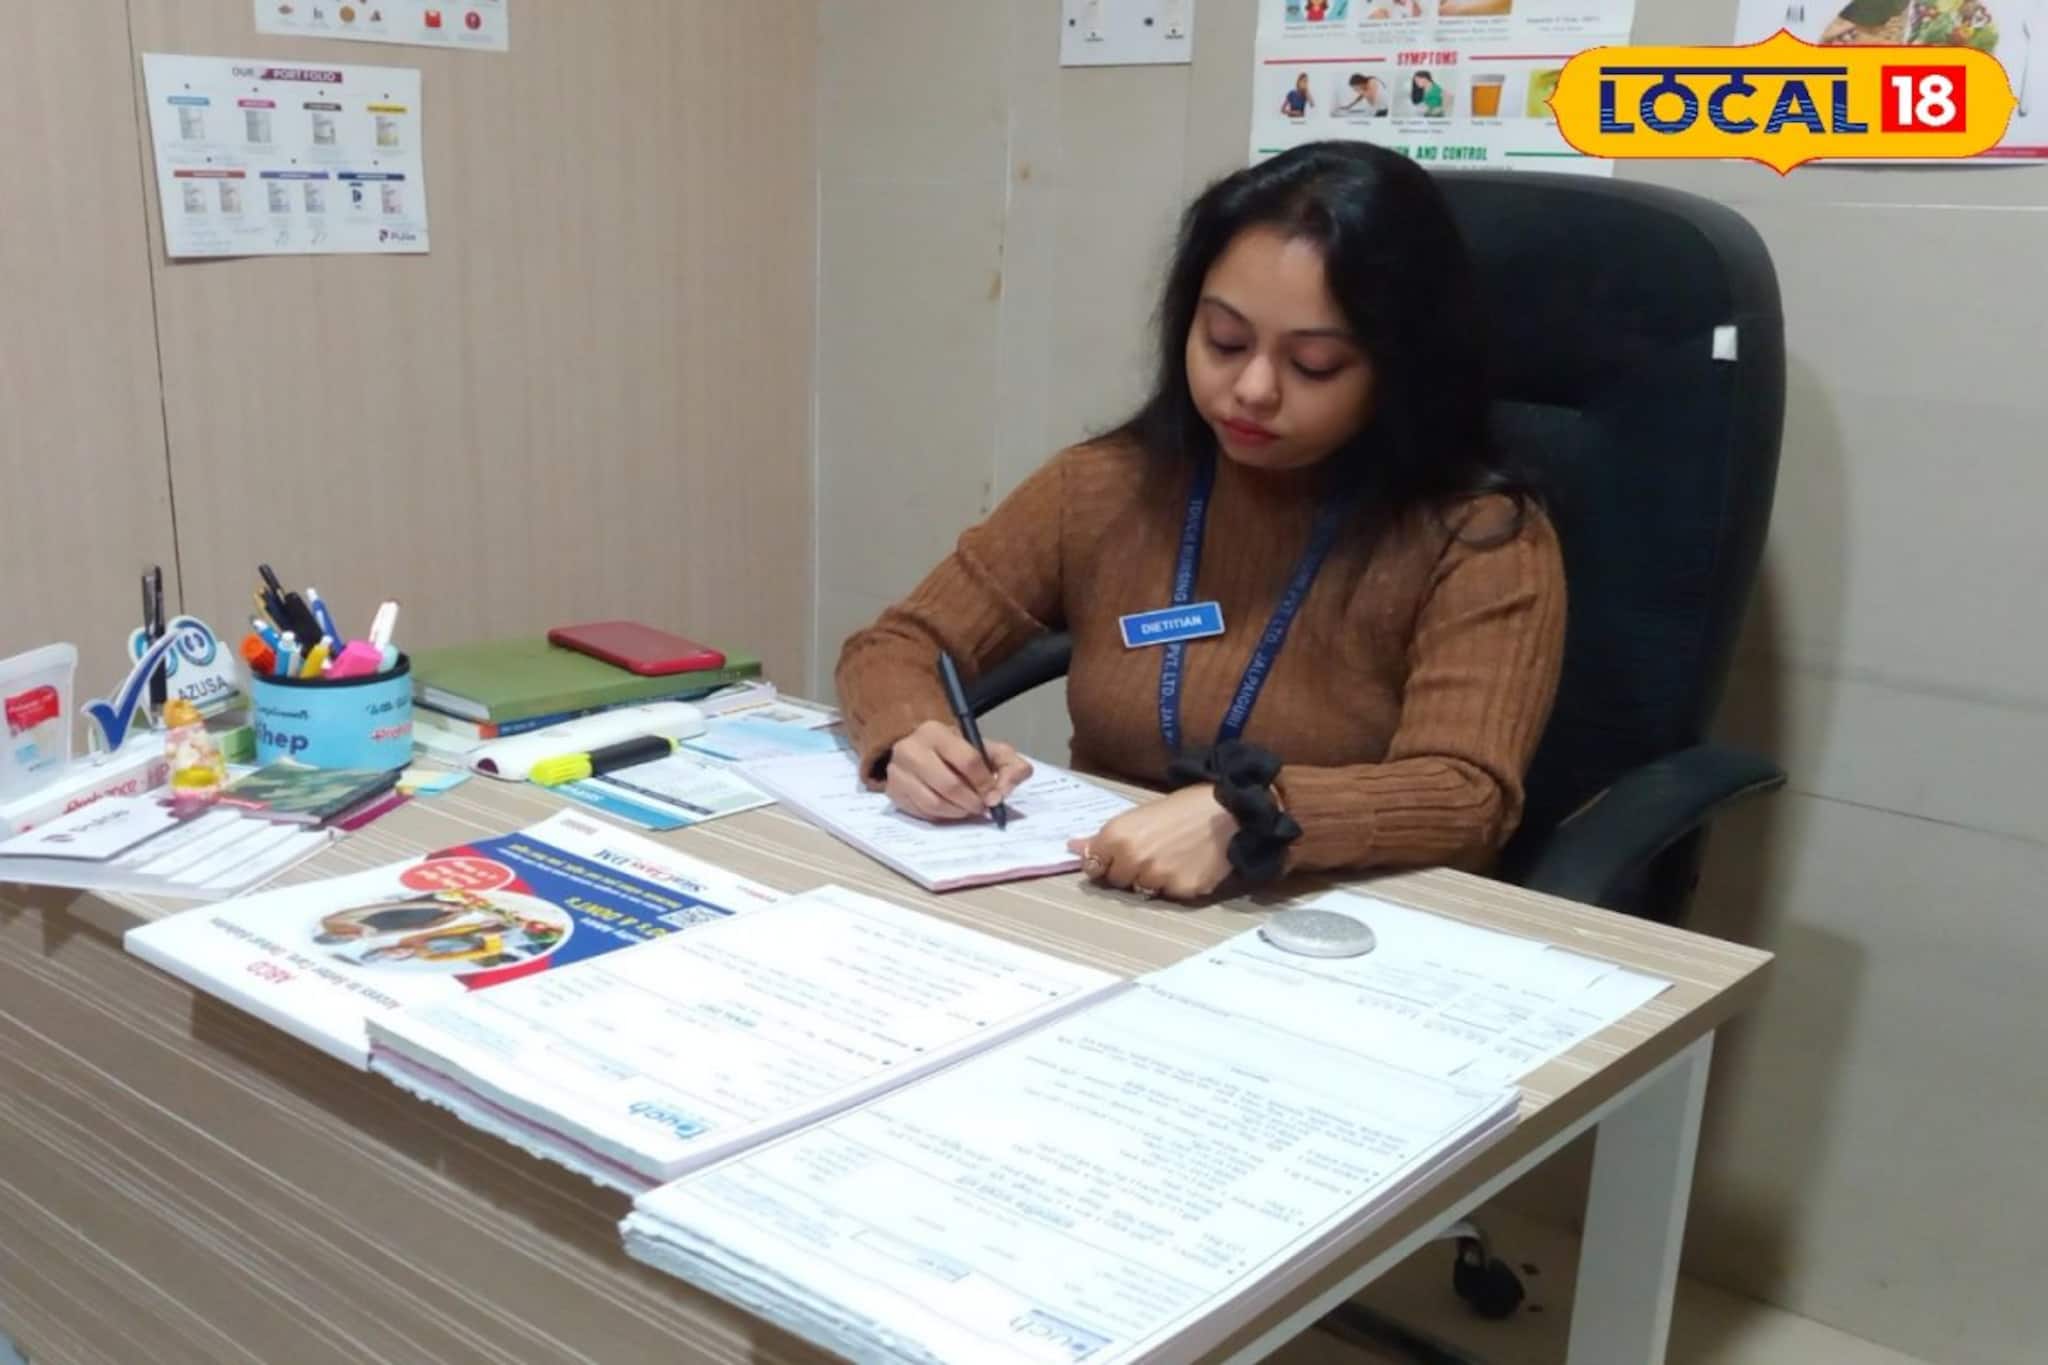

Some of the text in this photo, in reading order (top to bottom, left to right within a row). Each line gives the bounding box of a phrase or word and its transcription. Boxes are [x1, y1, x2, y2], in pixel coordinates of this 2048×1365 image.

[1397, 51, 1458, 65] SYMPTOMS
[1416, 146, 1438, 160] AND
[1442, 146, 1488, 161] CONTROL
[1140, 614, 1203, 635] DIETITIAN
